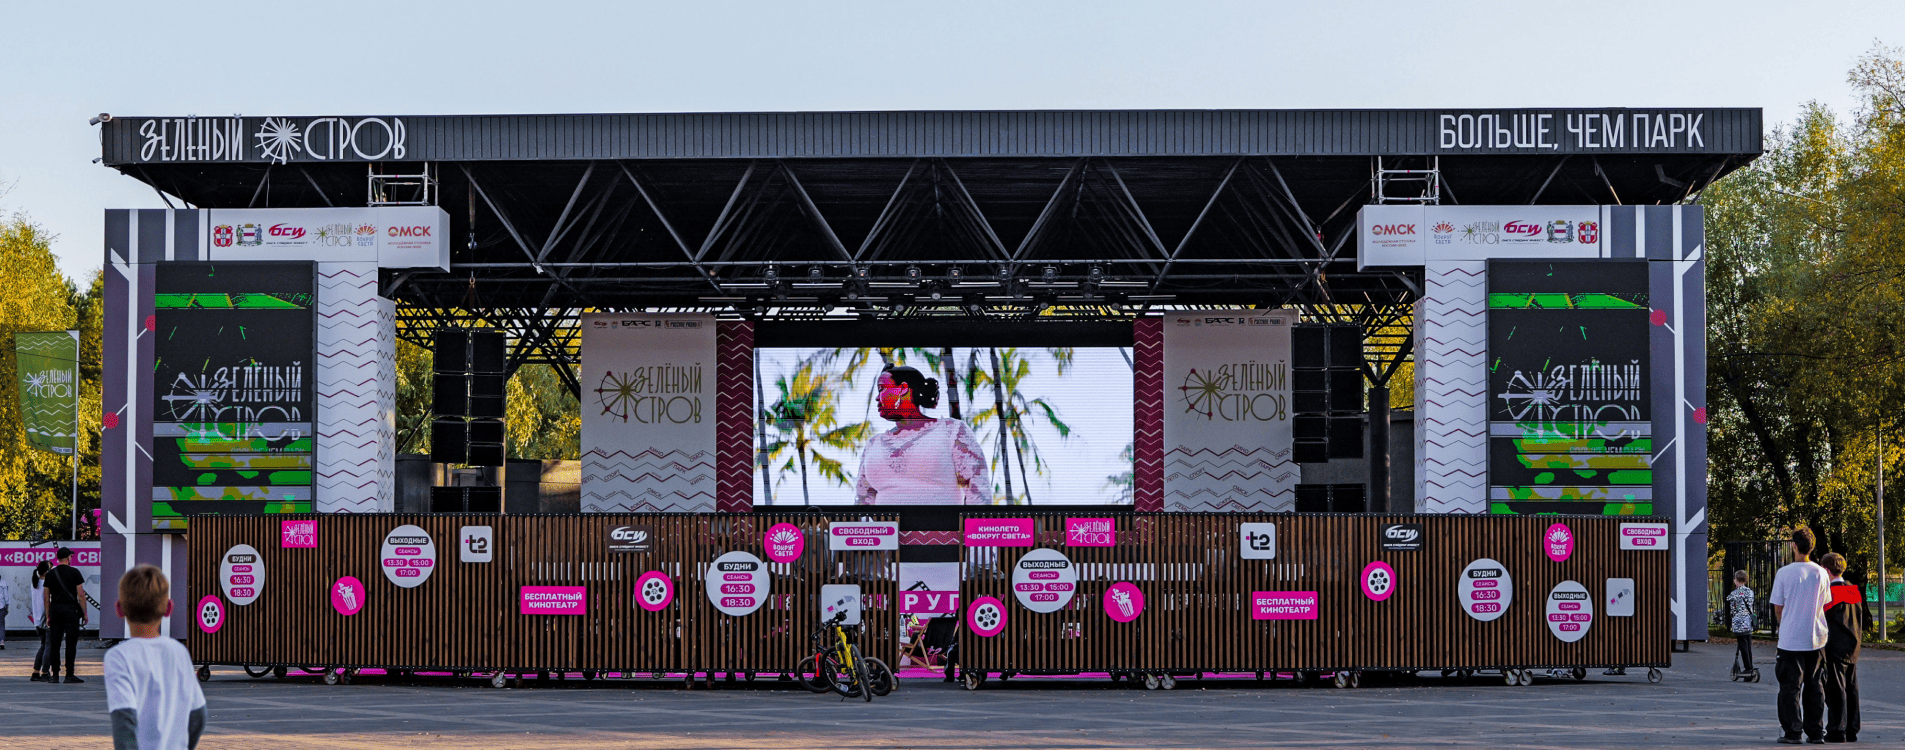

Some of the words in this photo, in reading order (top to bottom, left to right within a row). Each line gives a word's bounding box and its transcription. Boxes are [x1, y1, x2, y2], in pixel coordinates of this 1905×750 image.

[1440, 114, 1559, 150] БОЛЬШЕ,
[1567, 114, 1624, 148] ЧЕМ
[1632, 113, 1704, 148] ПАРК
[388, 226, 431, 237] ОМСК
[1372, 224, 1416, 235] ОМСК
[634, 362, 701, 394] ЗЕЛЁНЫЙ
[1218, 360, 1286, 391] ЗЕЛЁНЫЙ
[839, 527, 888, 535] СВОБОДНЫЙ
[465, 535, 487, 554] t2
[1246, 531, 1270, 550] t2
[77, 551, 101, 563] СВ
[525, 592, 582, 600] БЕСПЛАТНЫЙ
[1256, 597, 1314, 605] БЕСПЛАТНЫЙ
